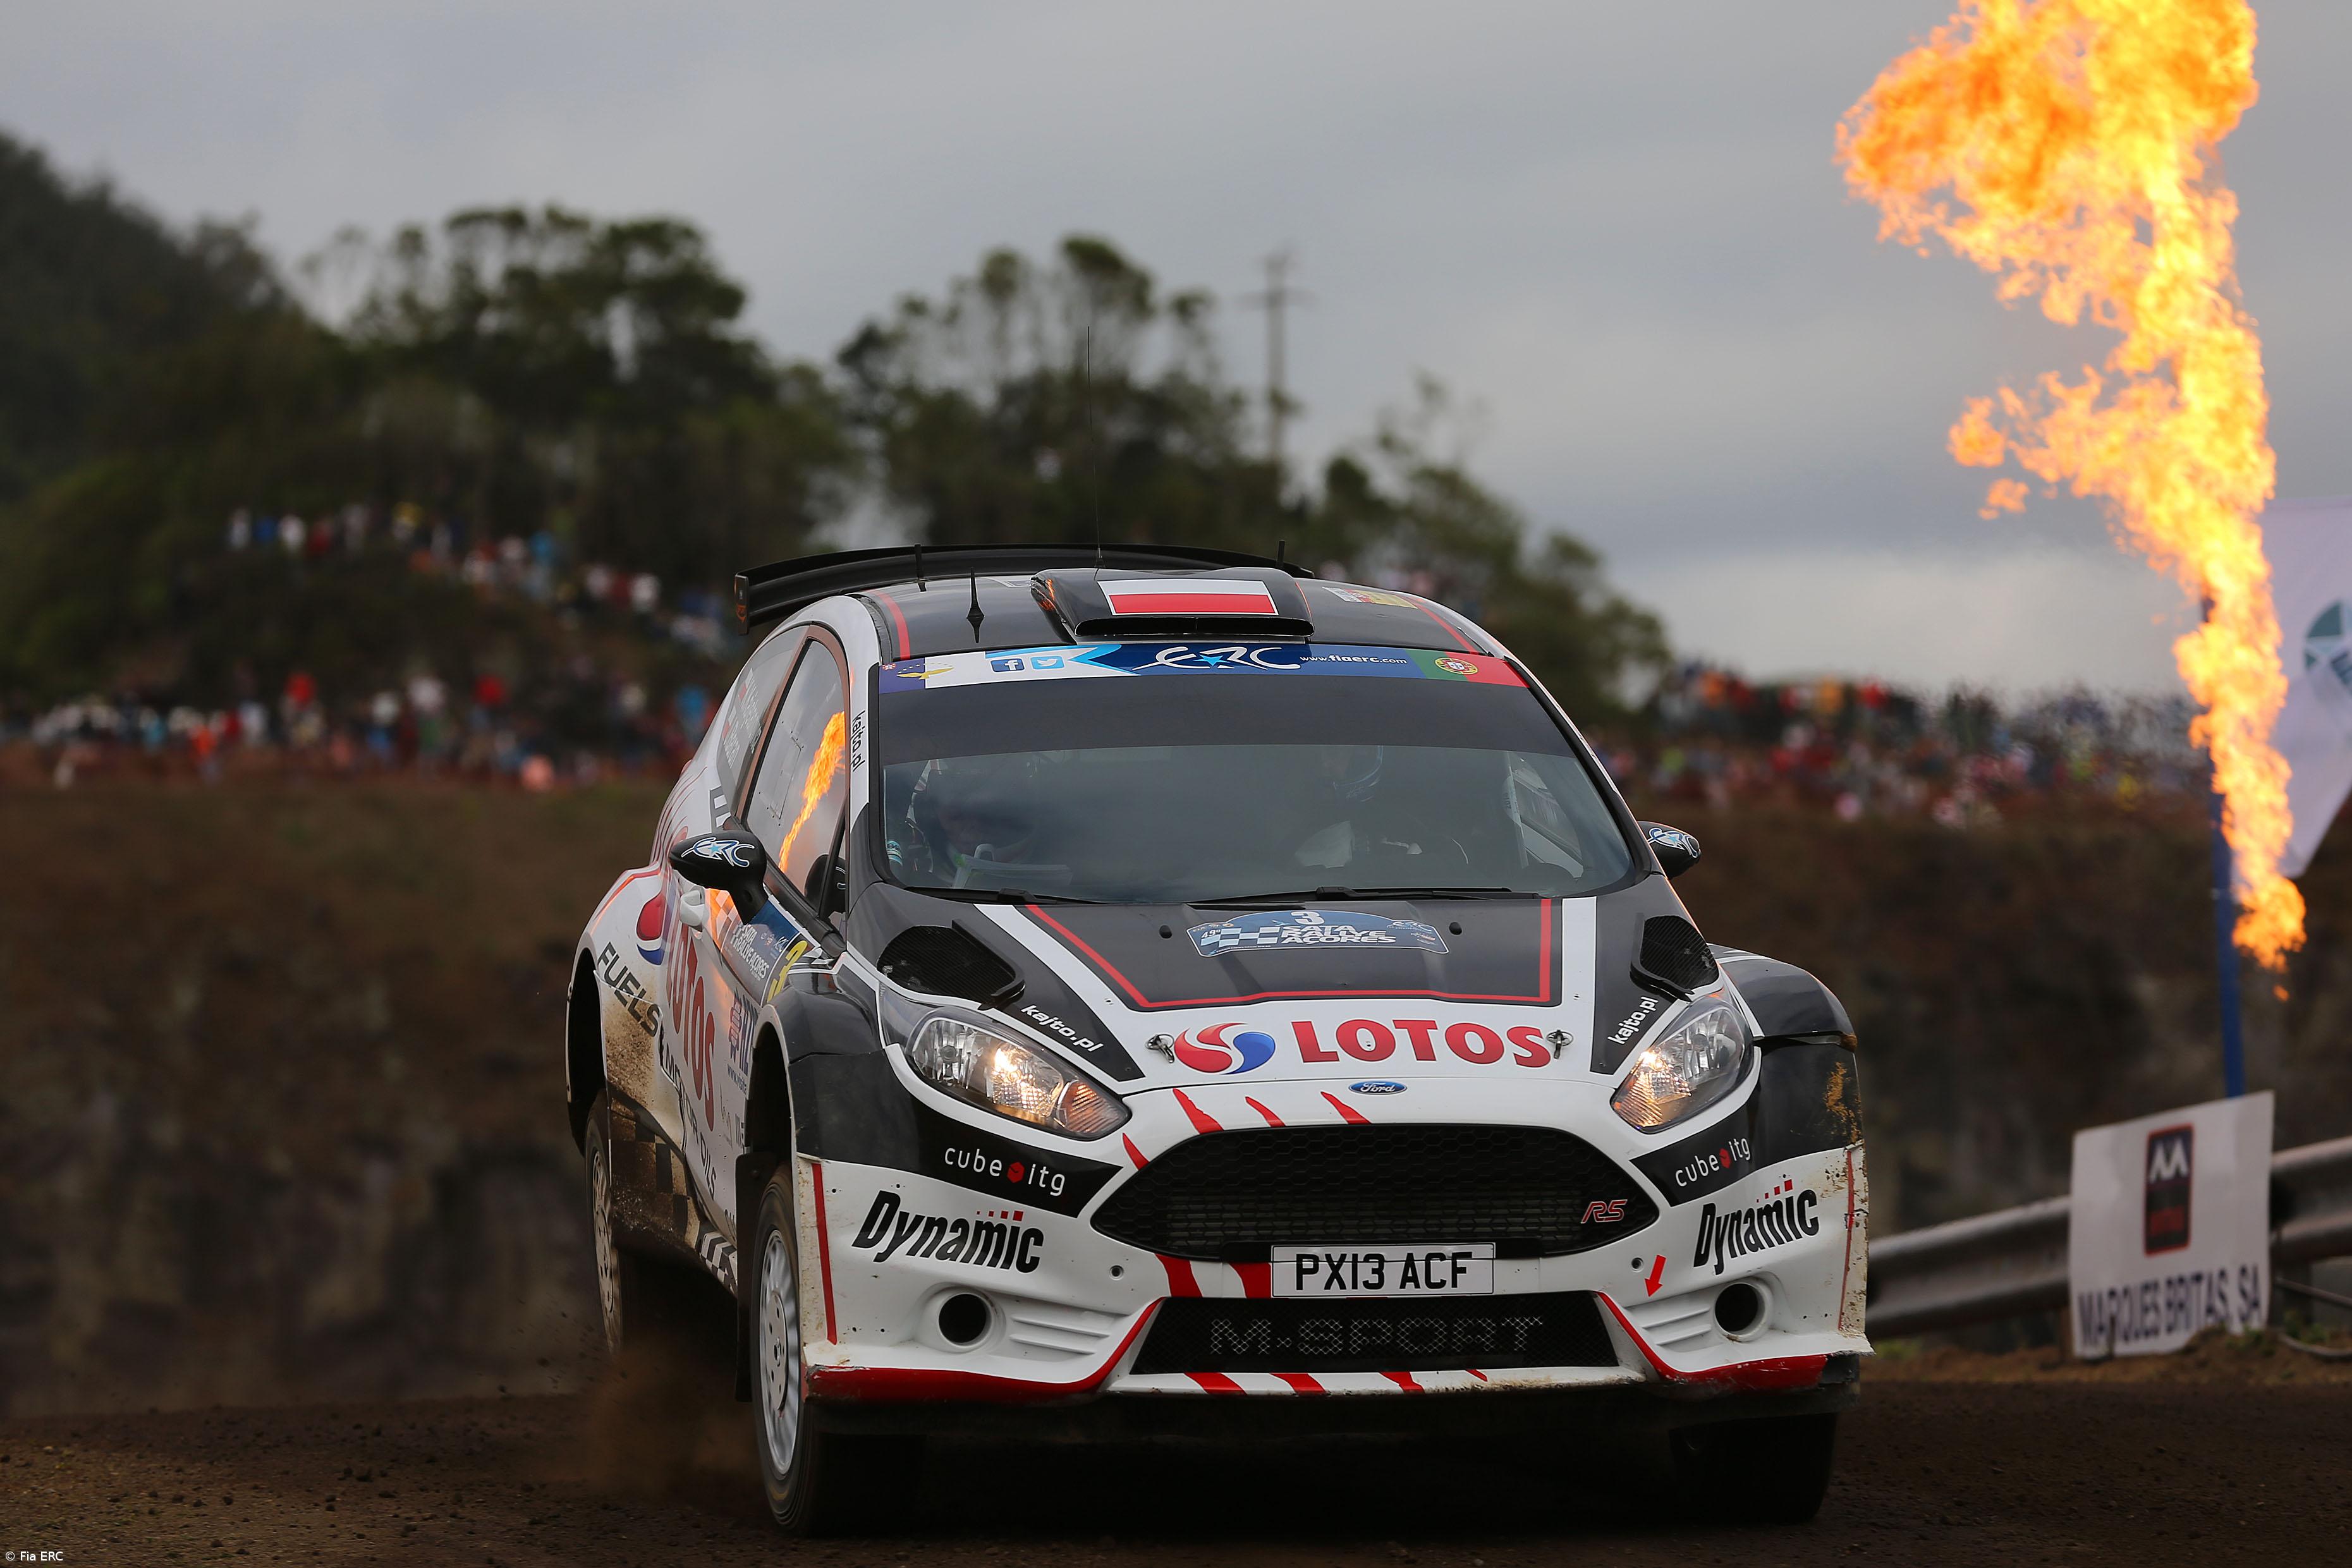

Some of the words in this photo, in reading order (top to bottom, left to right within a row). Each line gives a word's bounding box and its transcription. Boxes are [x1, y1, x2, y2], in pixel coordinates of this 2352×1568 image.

[1131, 647, 1301, 671] ERC
[1300, 653, 1408, 664] www.fiaerc.com
[850, 710, 865, 772] kajto.pl
[681, 837, 755, 868] ERC
[1281, 936, 1396, 945] AÇORES
[1291, 911, 1325, 925] 3
[597, 941, 661, 1037] FUELS
[666, 904, 716, 1133] LOTOS
[1020, 1005, 1104, 1052] kajto.pl
[1607, 996, 1659, 1045] kajto.pl
[1291, 1018, 1552, 1068] LOTOS
[1360, 1082, 1396, 1093] Ford
[665, 1043, 698, 1145] MOTOR
[700, 1131, 717, 1201] OILS
[851, 1190, 1045, 1273] Dynamic
[1693, 1186, 1820, 1275] Dynamic
[1295, 1253, 1386, 1291] PX13
[1399, 1251, 1473, 1289] ACF
